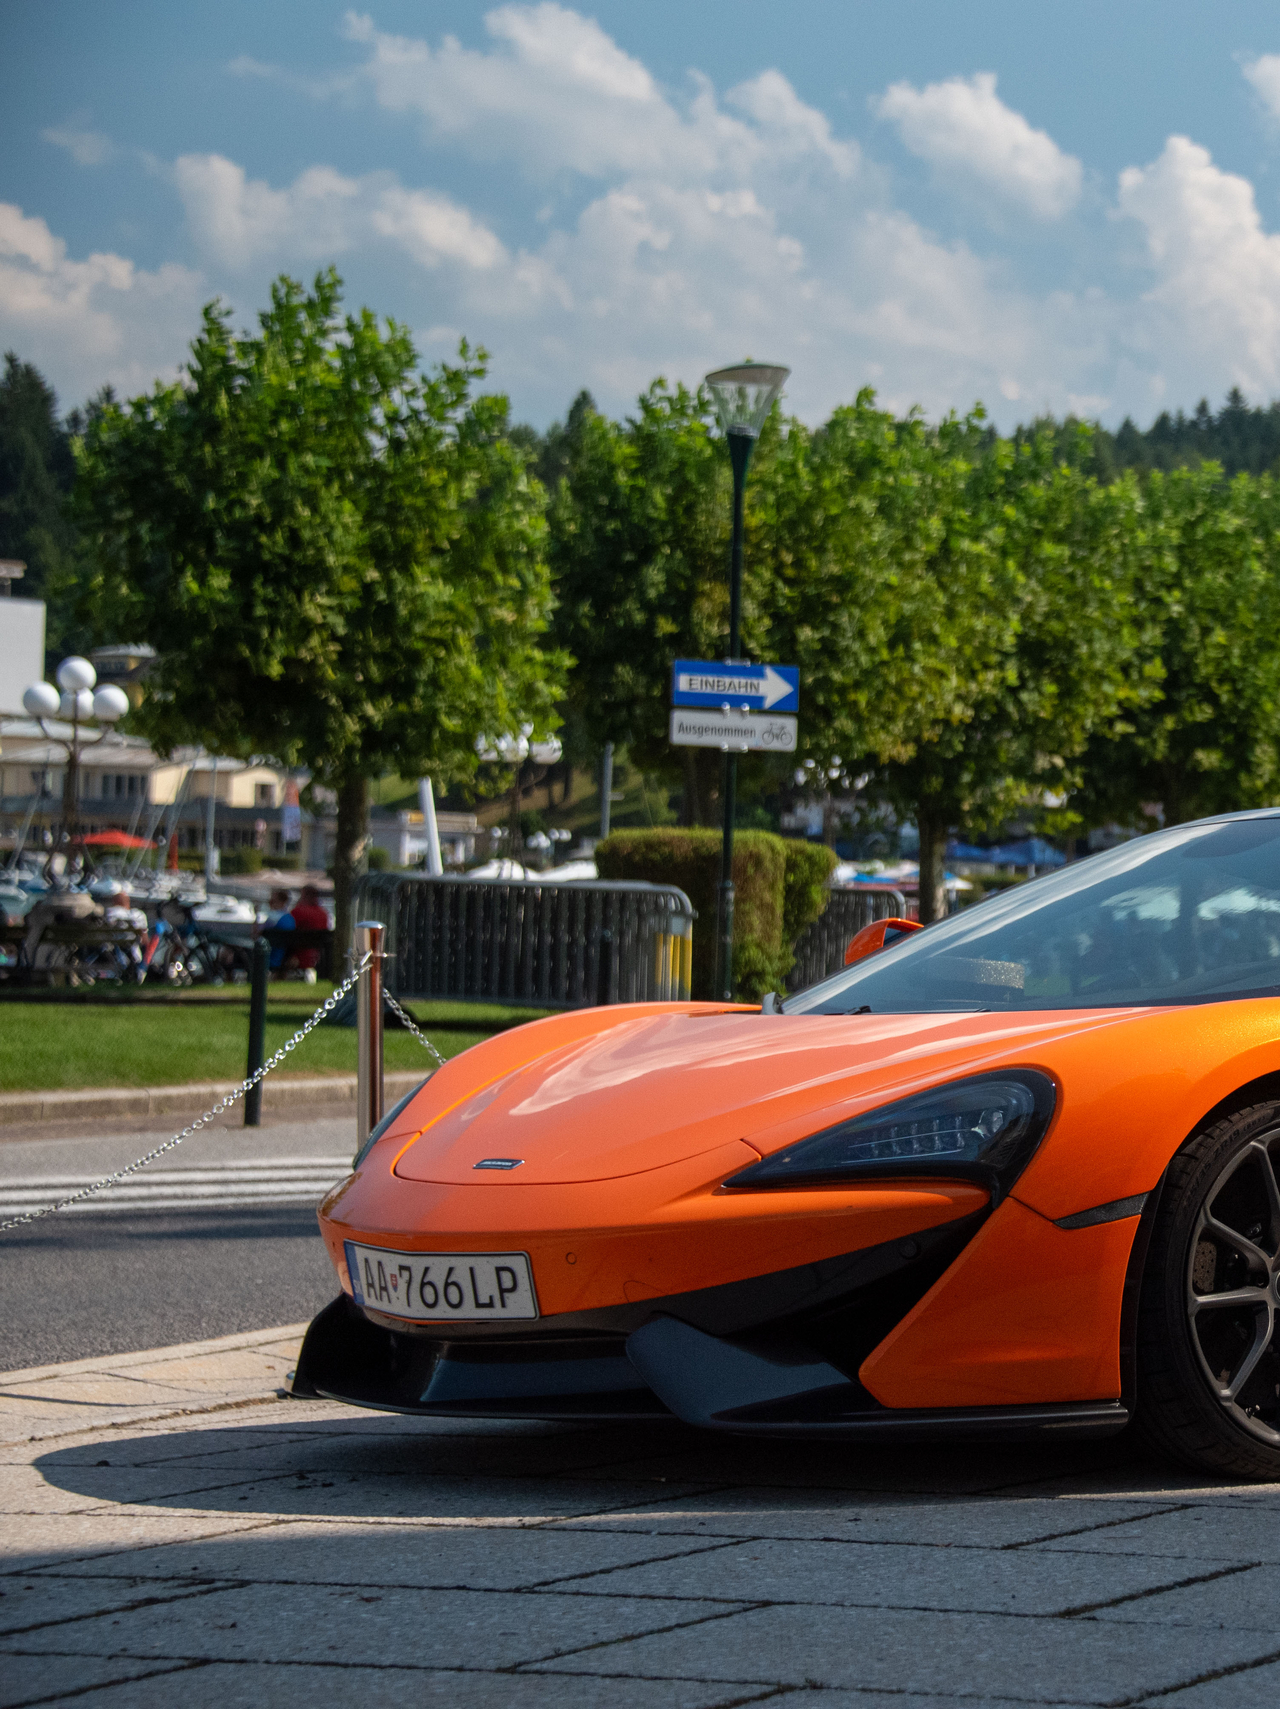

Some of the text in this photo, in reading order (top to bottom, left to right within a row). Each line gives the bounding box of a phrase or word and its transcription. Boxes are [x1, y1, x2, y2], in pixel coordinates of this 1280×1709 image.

[688, 677, 760, 694] EINBAHN
[678, 721, 756, 739] Ausgenommen
[364, 1257, 518, 1309] AA 766LP
